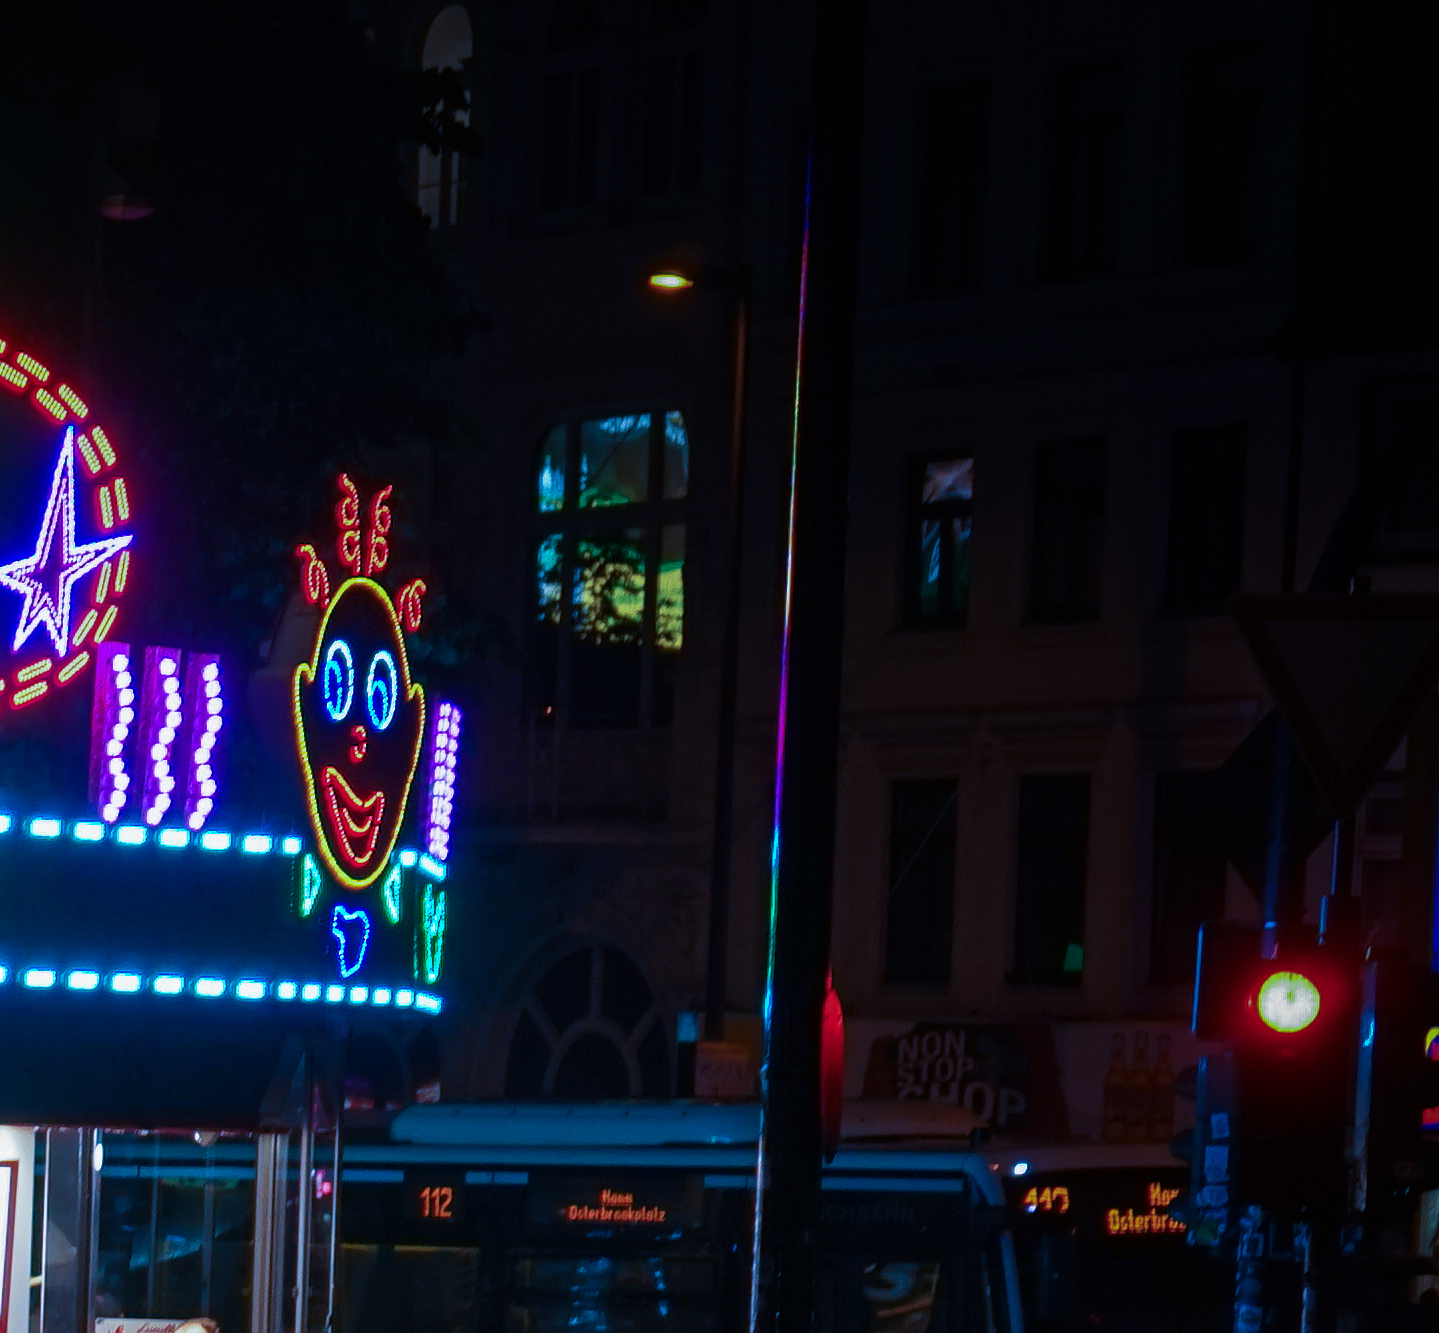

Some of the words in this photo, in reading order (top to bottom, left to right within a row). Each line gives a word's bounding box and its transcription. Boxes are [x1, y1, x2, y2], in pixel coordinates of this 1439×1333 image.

[896, 1030, 967, 1065] NON
[895, 1056, 974, 1088] STOP
[420, 1187, 452, 1217] 112
